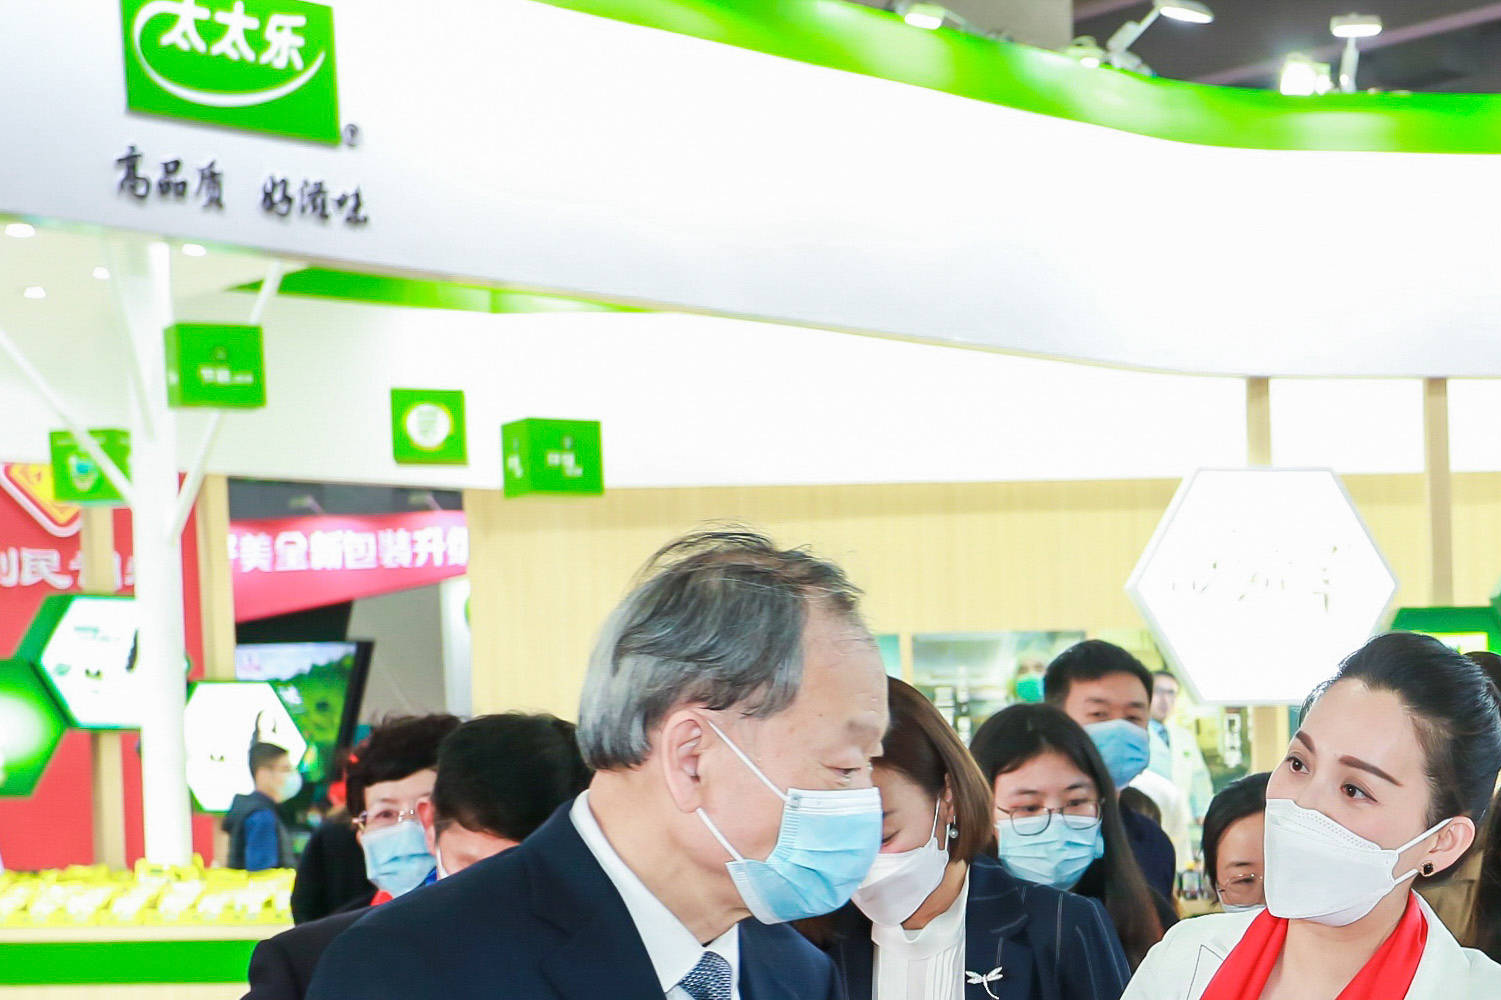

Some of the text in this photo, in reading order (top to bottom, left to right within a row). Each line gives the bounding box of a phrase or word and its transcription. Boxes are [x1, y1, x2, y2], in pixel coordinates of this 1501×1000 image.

[158, 0, 308, 71] 太太乐
[115, 145, 225, 212] 高品质
